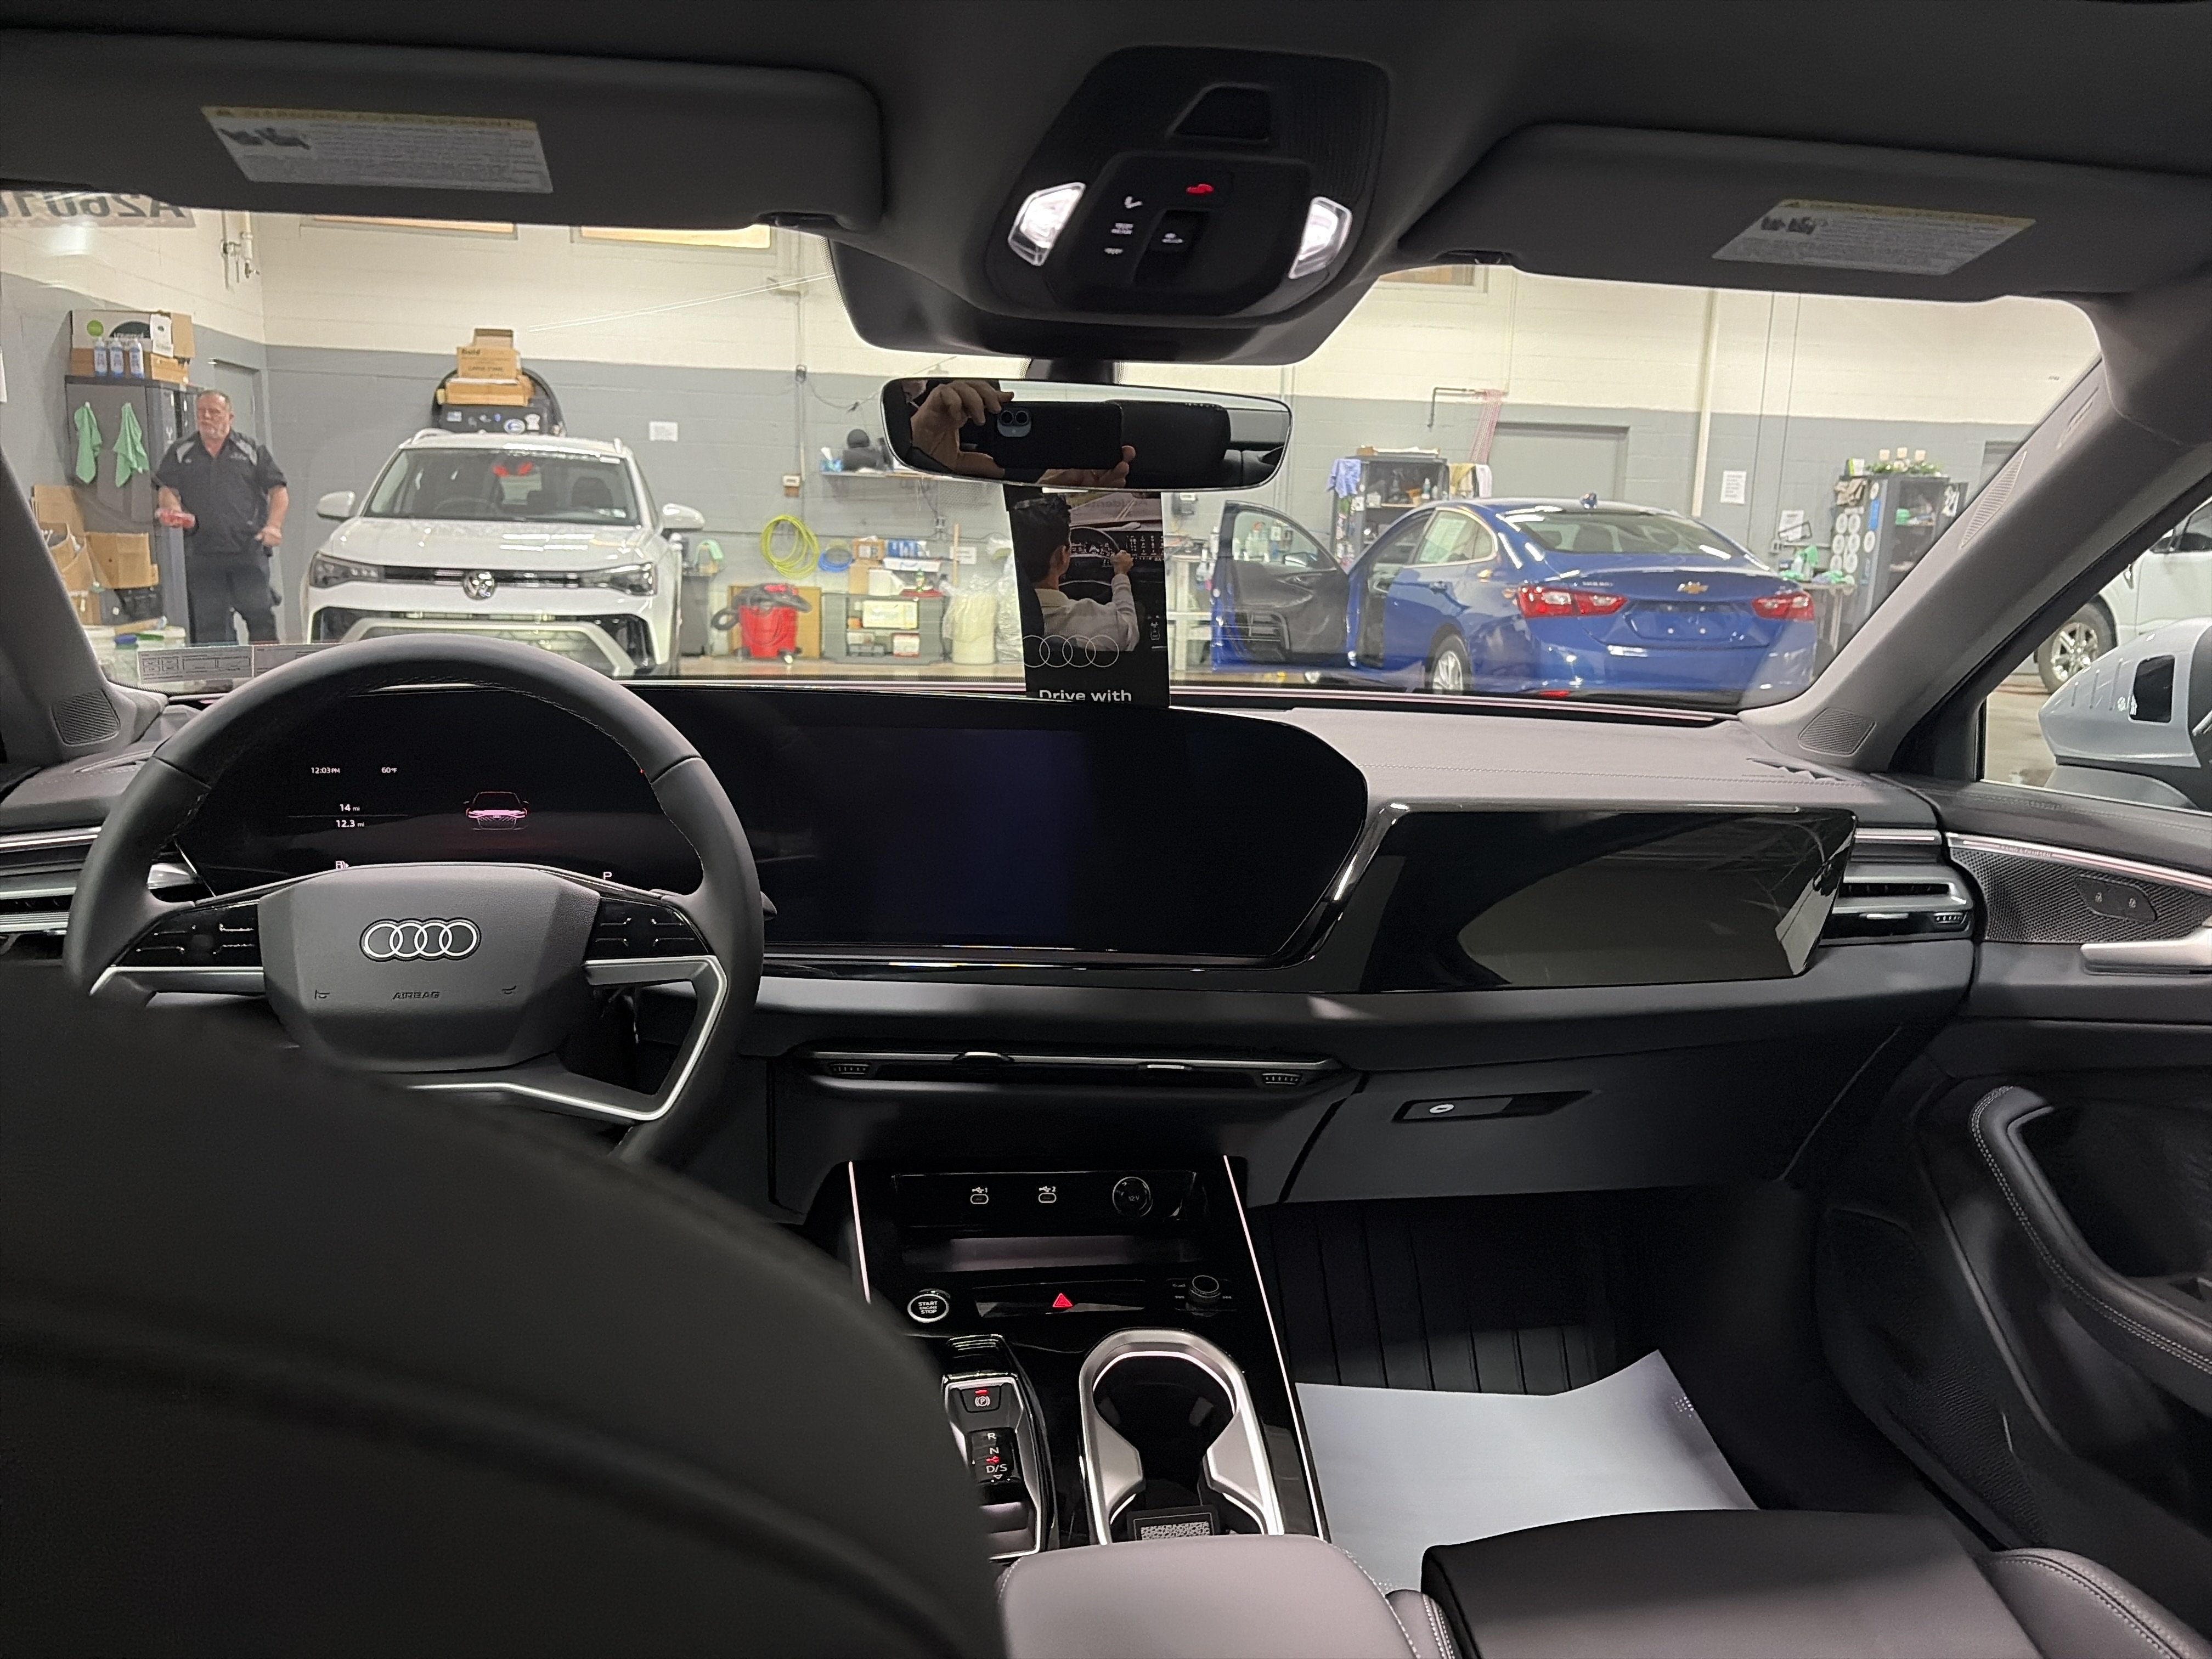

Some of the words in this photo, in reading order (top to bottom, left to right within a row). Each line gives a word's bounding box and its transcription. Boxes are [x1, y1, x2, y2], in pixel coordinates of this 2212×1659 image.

[1039, 689, 1086, 701] Drive
[1091, 689, 1132, 702] with
[603, 871, 612, 880] P
[987, 1464, 1007, 1473] D/S
